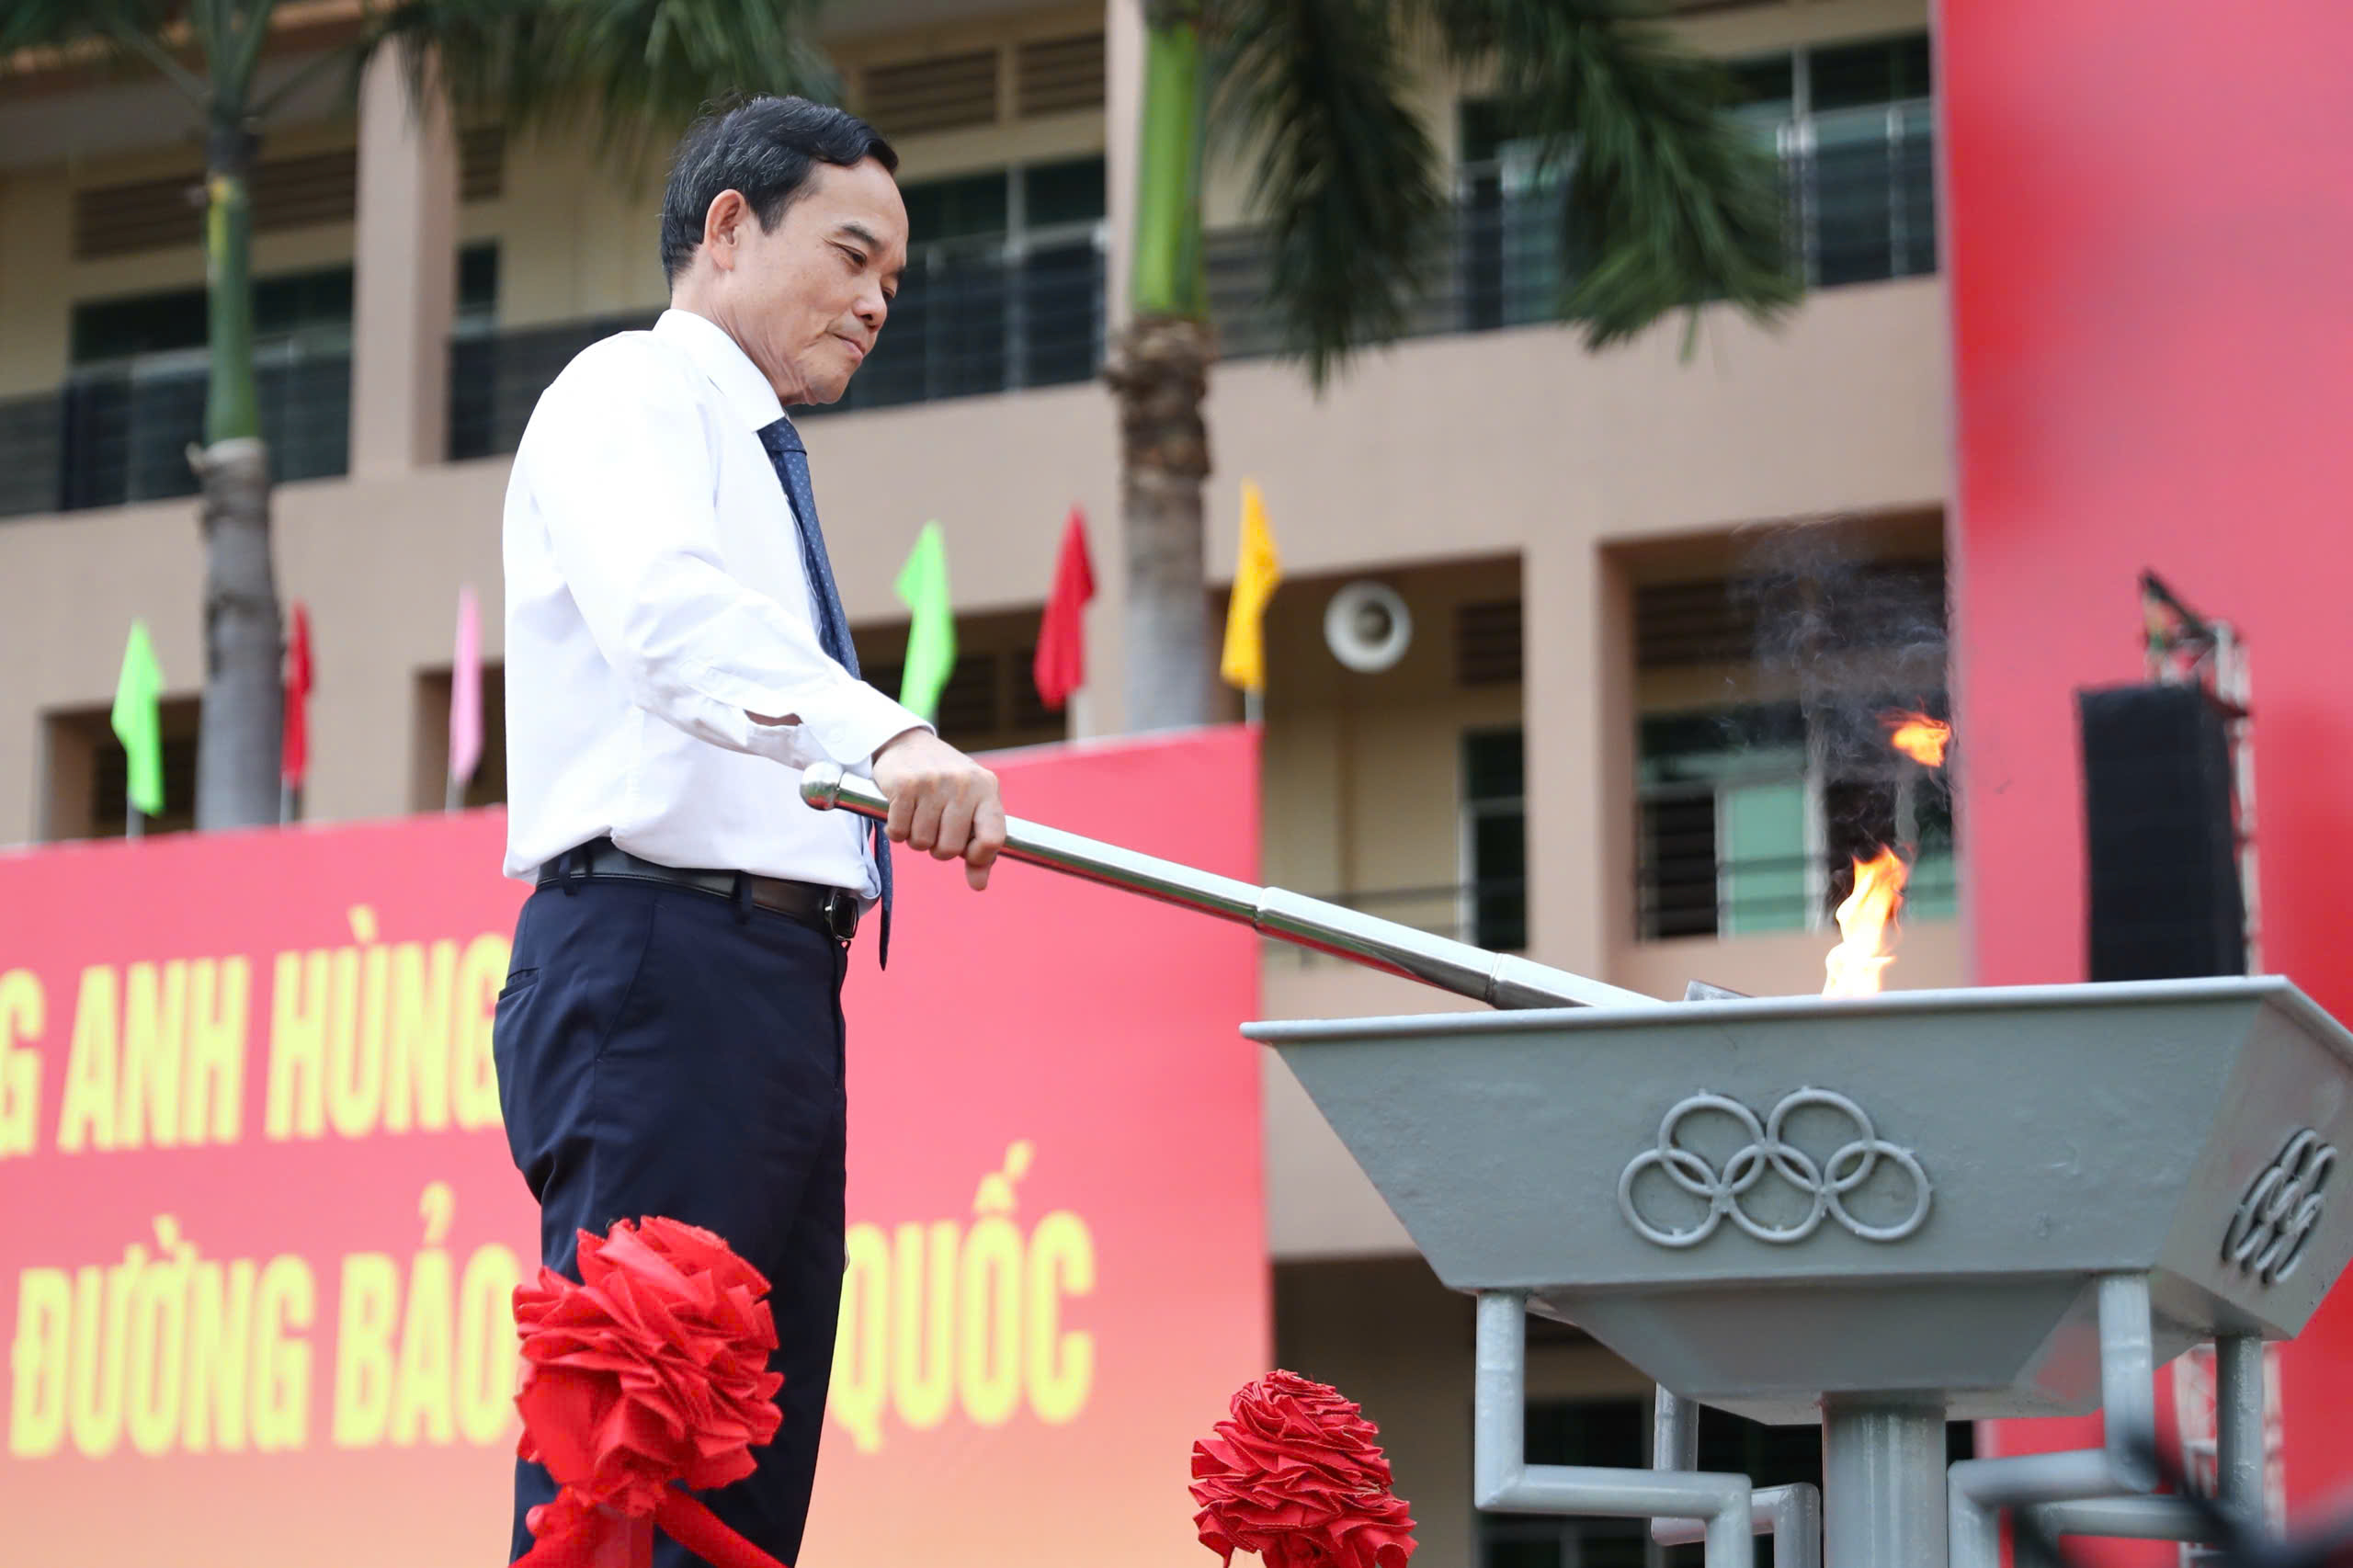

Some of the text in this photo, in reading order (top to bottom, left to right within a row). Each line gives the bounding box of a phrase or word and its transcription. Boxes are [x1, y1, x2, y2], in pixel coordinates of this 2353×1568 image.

[57, 955, 250, 1153] ANH
[266, 904, 512, 1142] HÙNG
[7, 1140, 1097, 1461] ĐƯỜNG BẢO QUỐC
